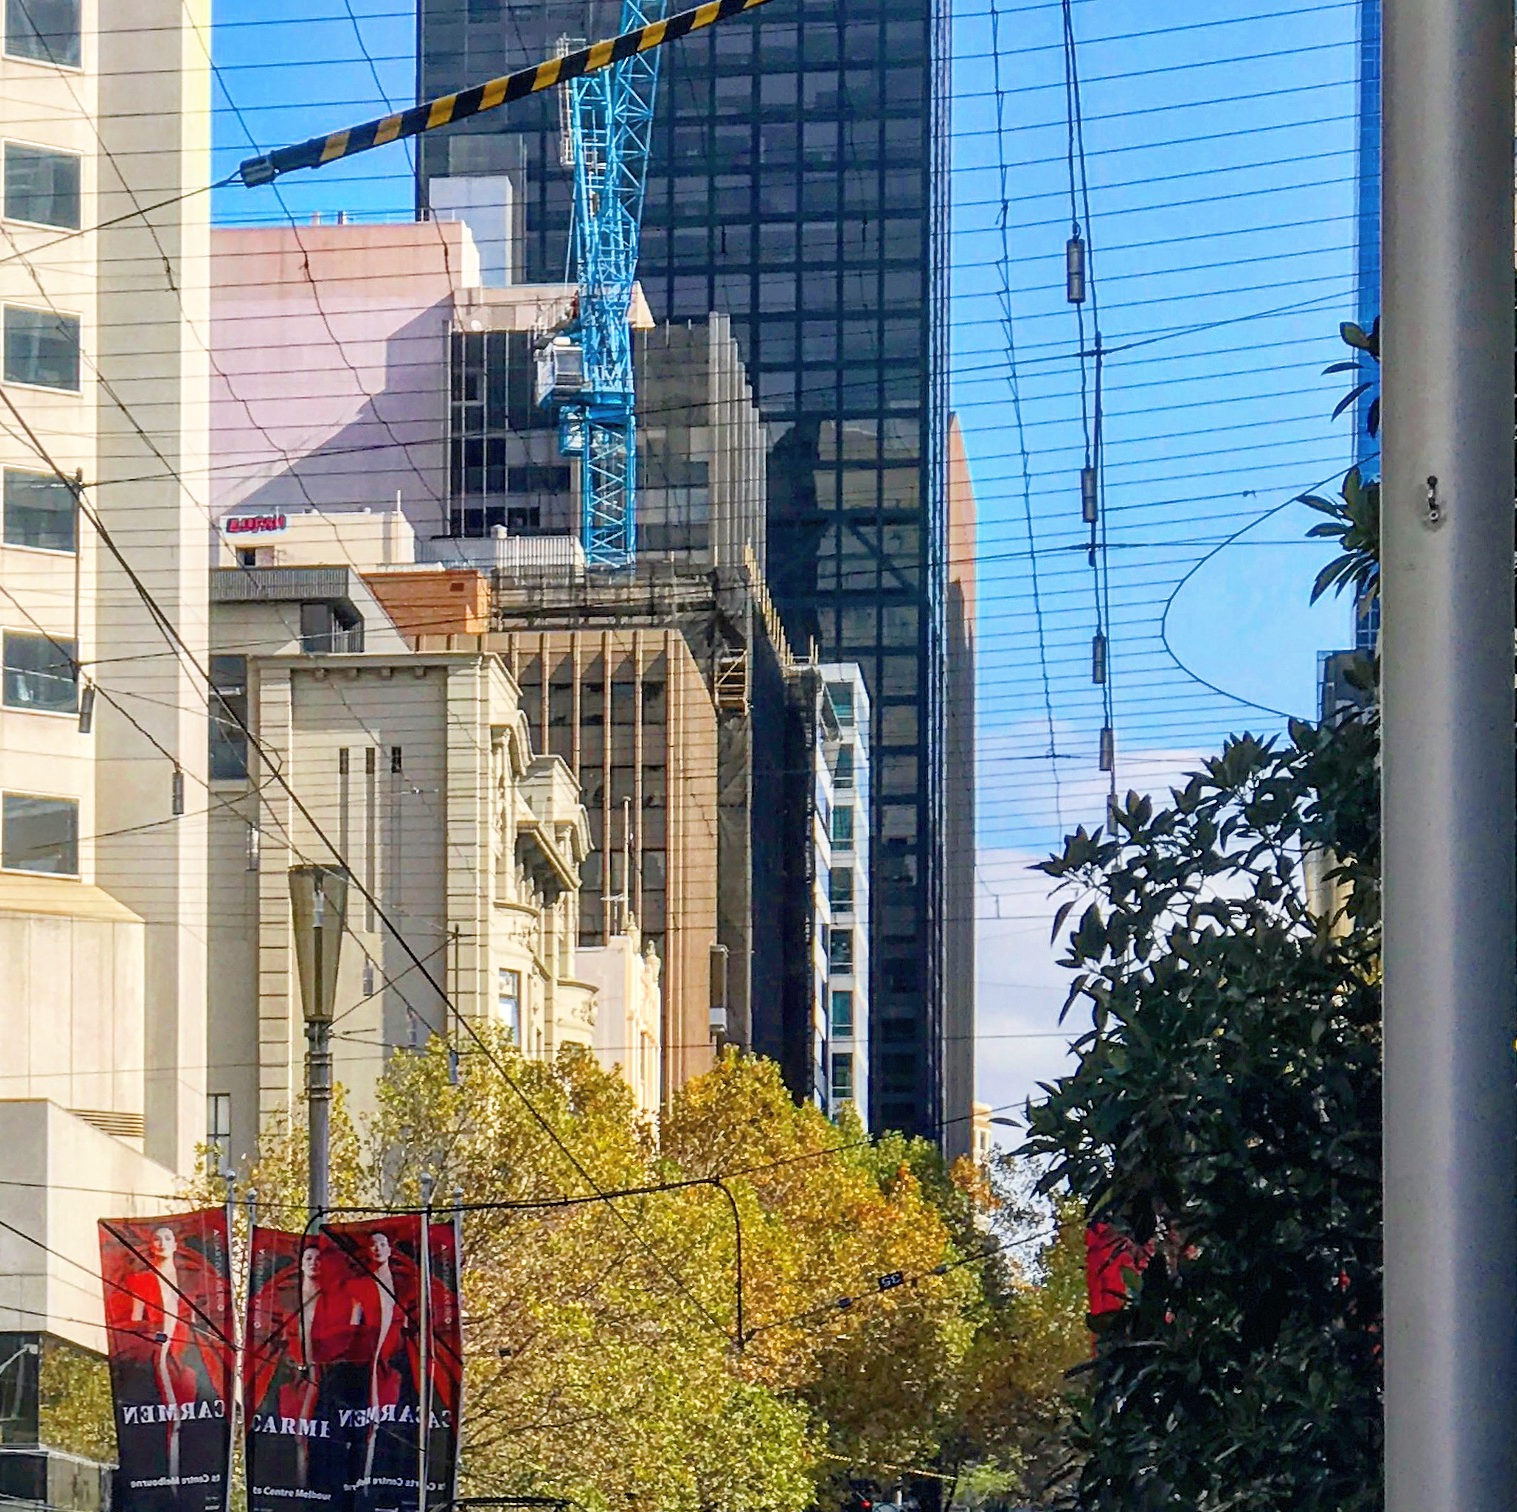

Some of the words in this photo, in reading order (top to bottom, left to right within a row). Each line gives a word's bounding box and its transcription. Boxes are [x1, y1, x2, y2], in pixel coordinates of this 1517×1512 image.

[253, 1413, 331, 1438] CARME
[263, 1486, 295, 1498] Centre
[295, 1488, 332, 1501] Melbour
